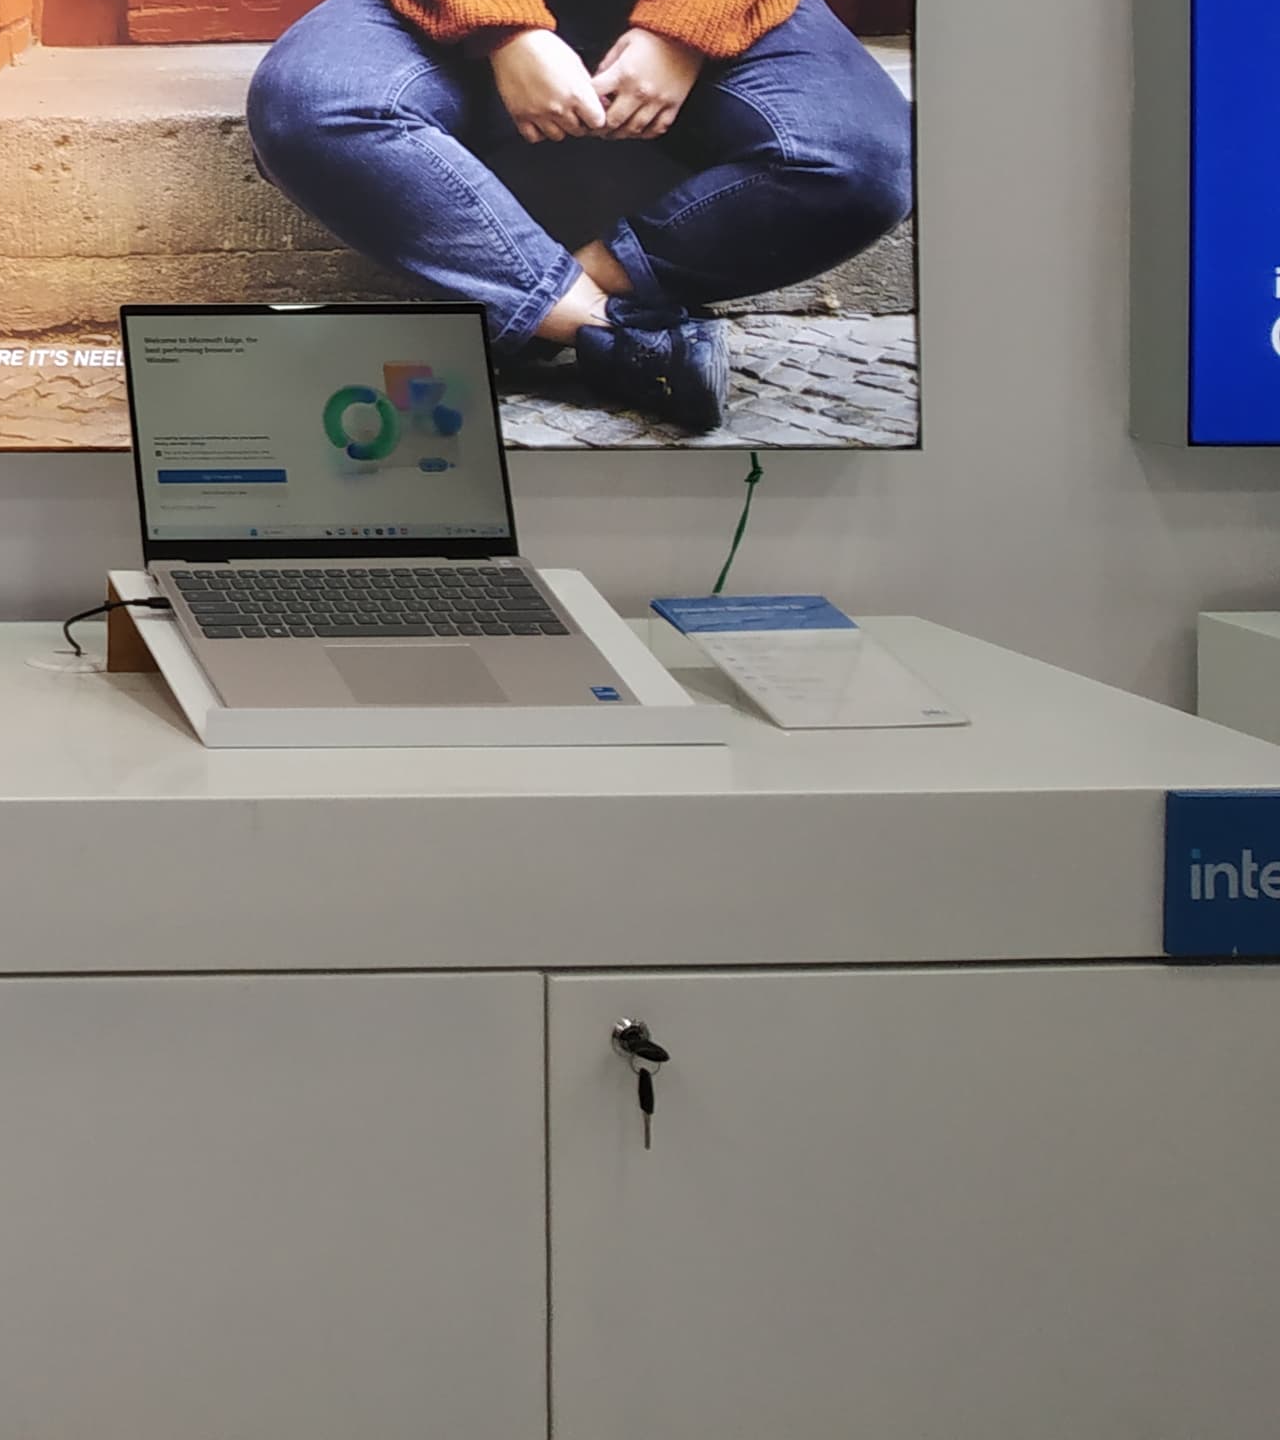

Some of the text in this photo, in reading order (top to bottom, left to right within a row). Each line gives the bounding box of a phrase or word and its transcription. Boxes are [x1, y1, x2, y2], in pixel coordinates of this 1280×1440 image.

[144, 336, 177, 344] Welcome
[189, 336, 223, 344] Microsoft
[162, 347, 203, 355] performing
[28, 349, 69, 367] IT'S
